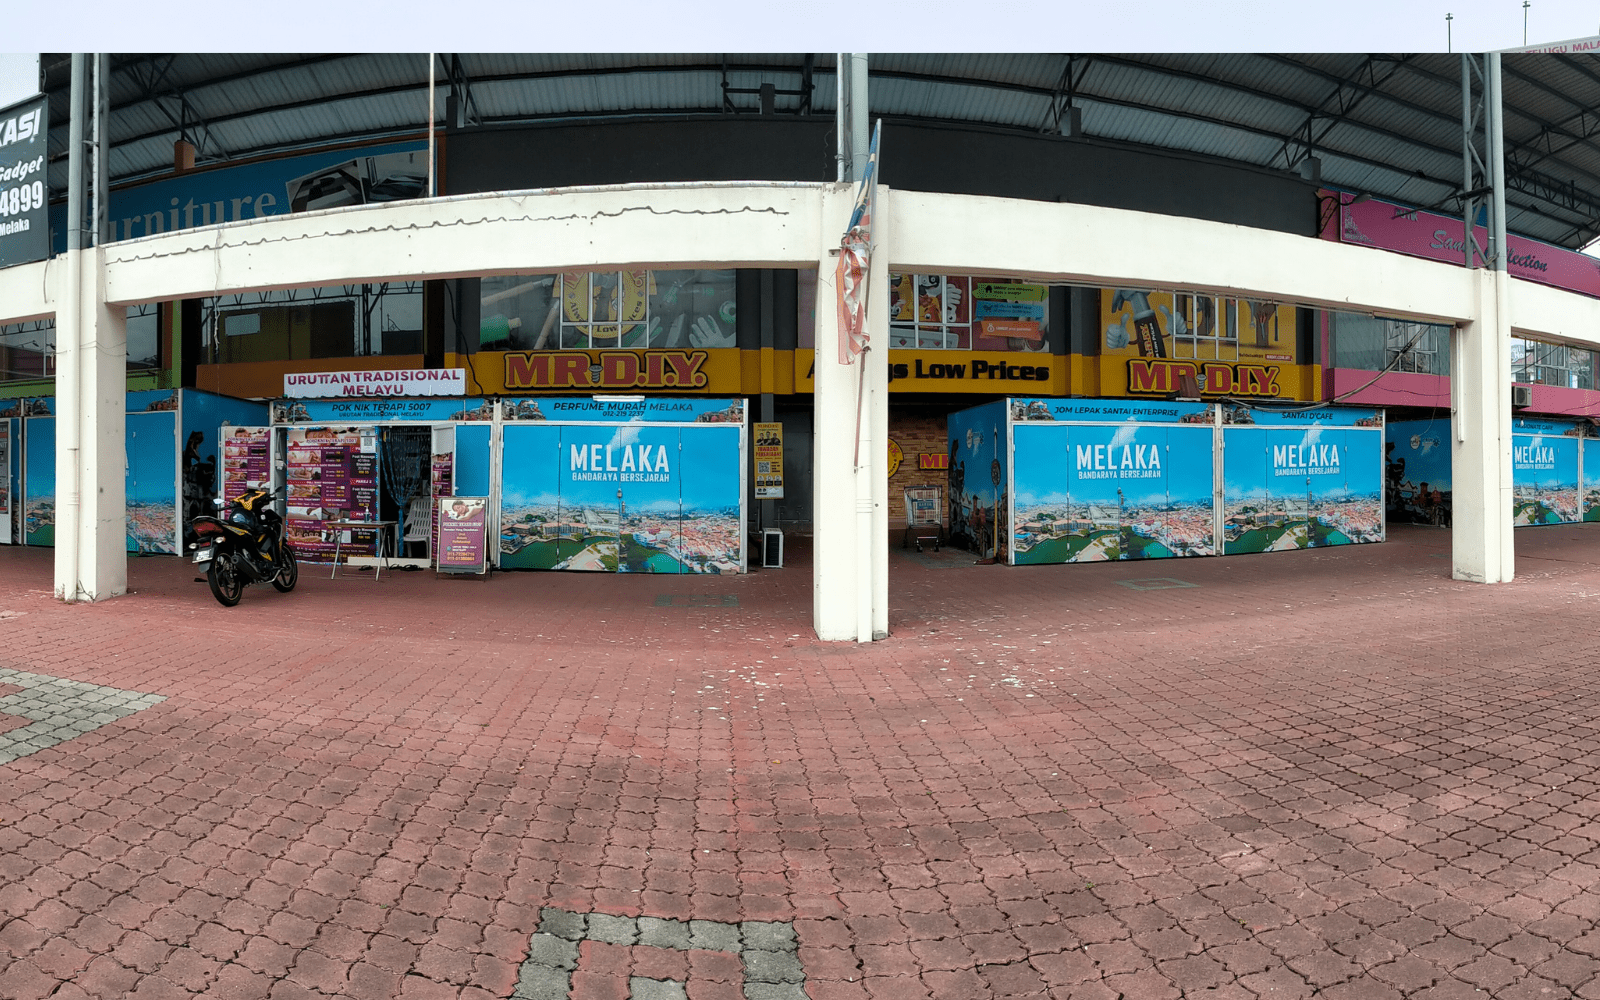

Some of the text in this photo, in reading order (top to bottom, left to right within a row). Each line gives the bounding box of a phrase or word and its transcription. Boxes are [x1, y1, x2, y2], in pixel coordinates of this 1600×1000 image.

[0, 107, 42, 146] ASI
[354, 370, 461, 383] TRADISIONAL
[915, 359, 966, 379] Low
[971, 360, 1050, 381] Prices
[343, 384, 404, 395] MELAYU
[373, 403, 406, 411] TERAPI
[408, 403, 432, 411] 5007
[553, 402, 693, 411] PERFUME MURAH MELAKA
[1133, 408, 1179, 416] ENTERPRISE
[570, 444, 670, 473] MELAKA
[1076, 444, 1161, 470] MELAKA
[1273, 444, 1340, 468] MELAKA
[1514, 446, 1555, 464] MELAKA
[572, 472, 670, 482] BANDARAYA BERSEJARAH
[1078, 470, 1161, 479] BANDARAYA BERSEJARAH
